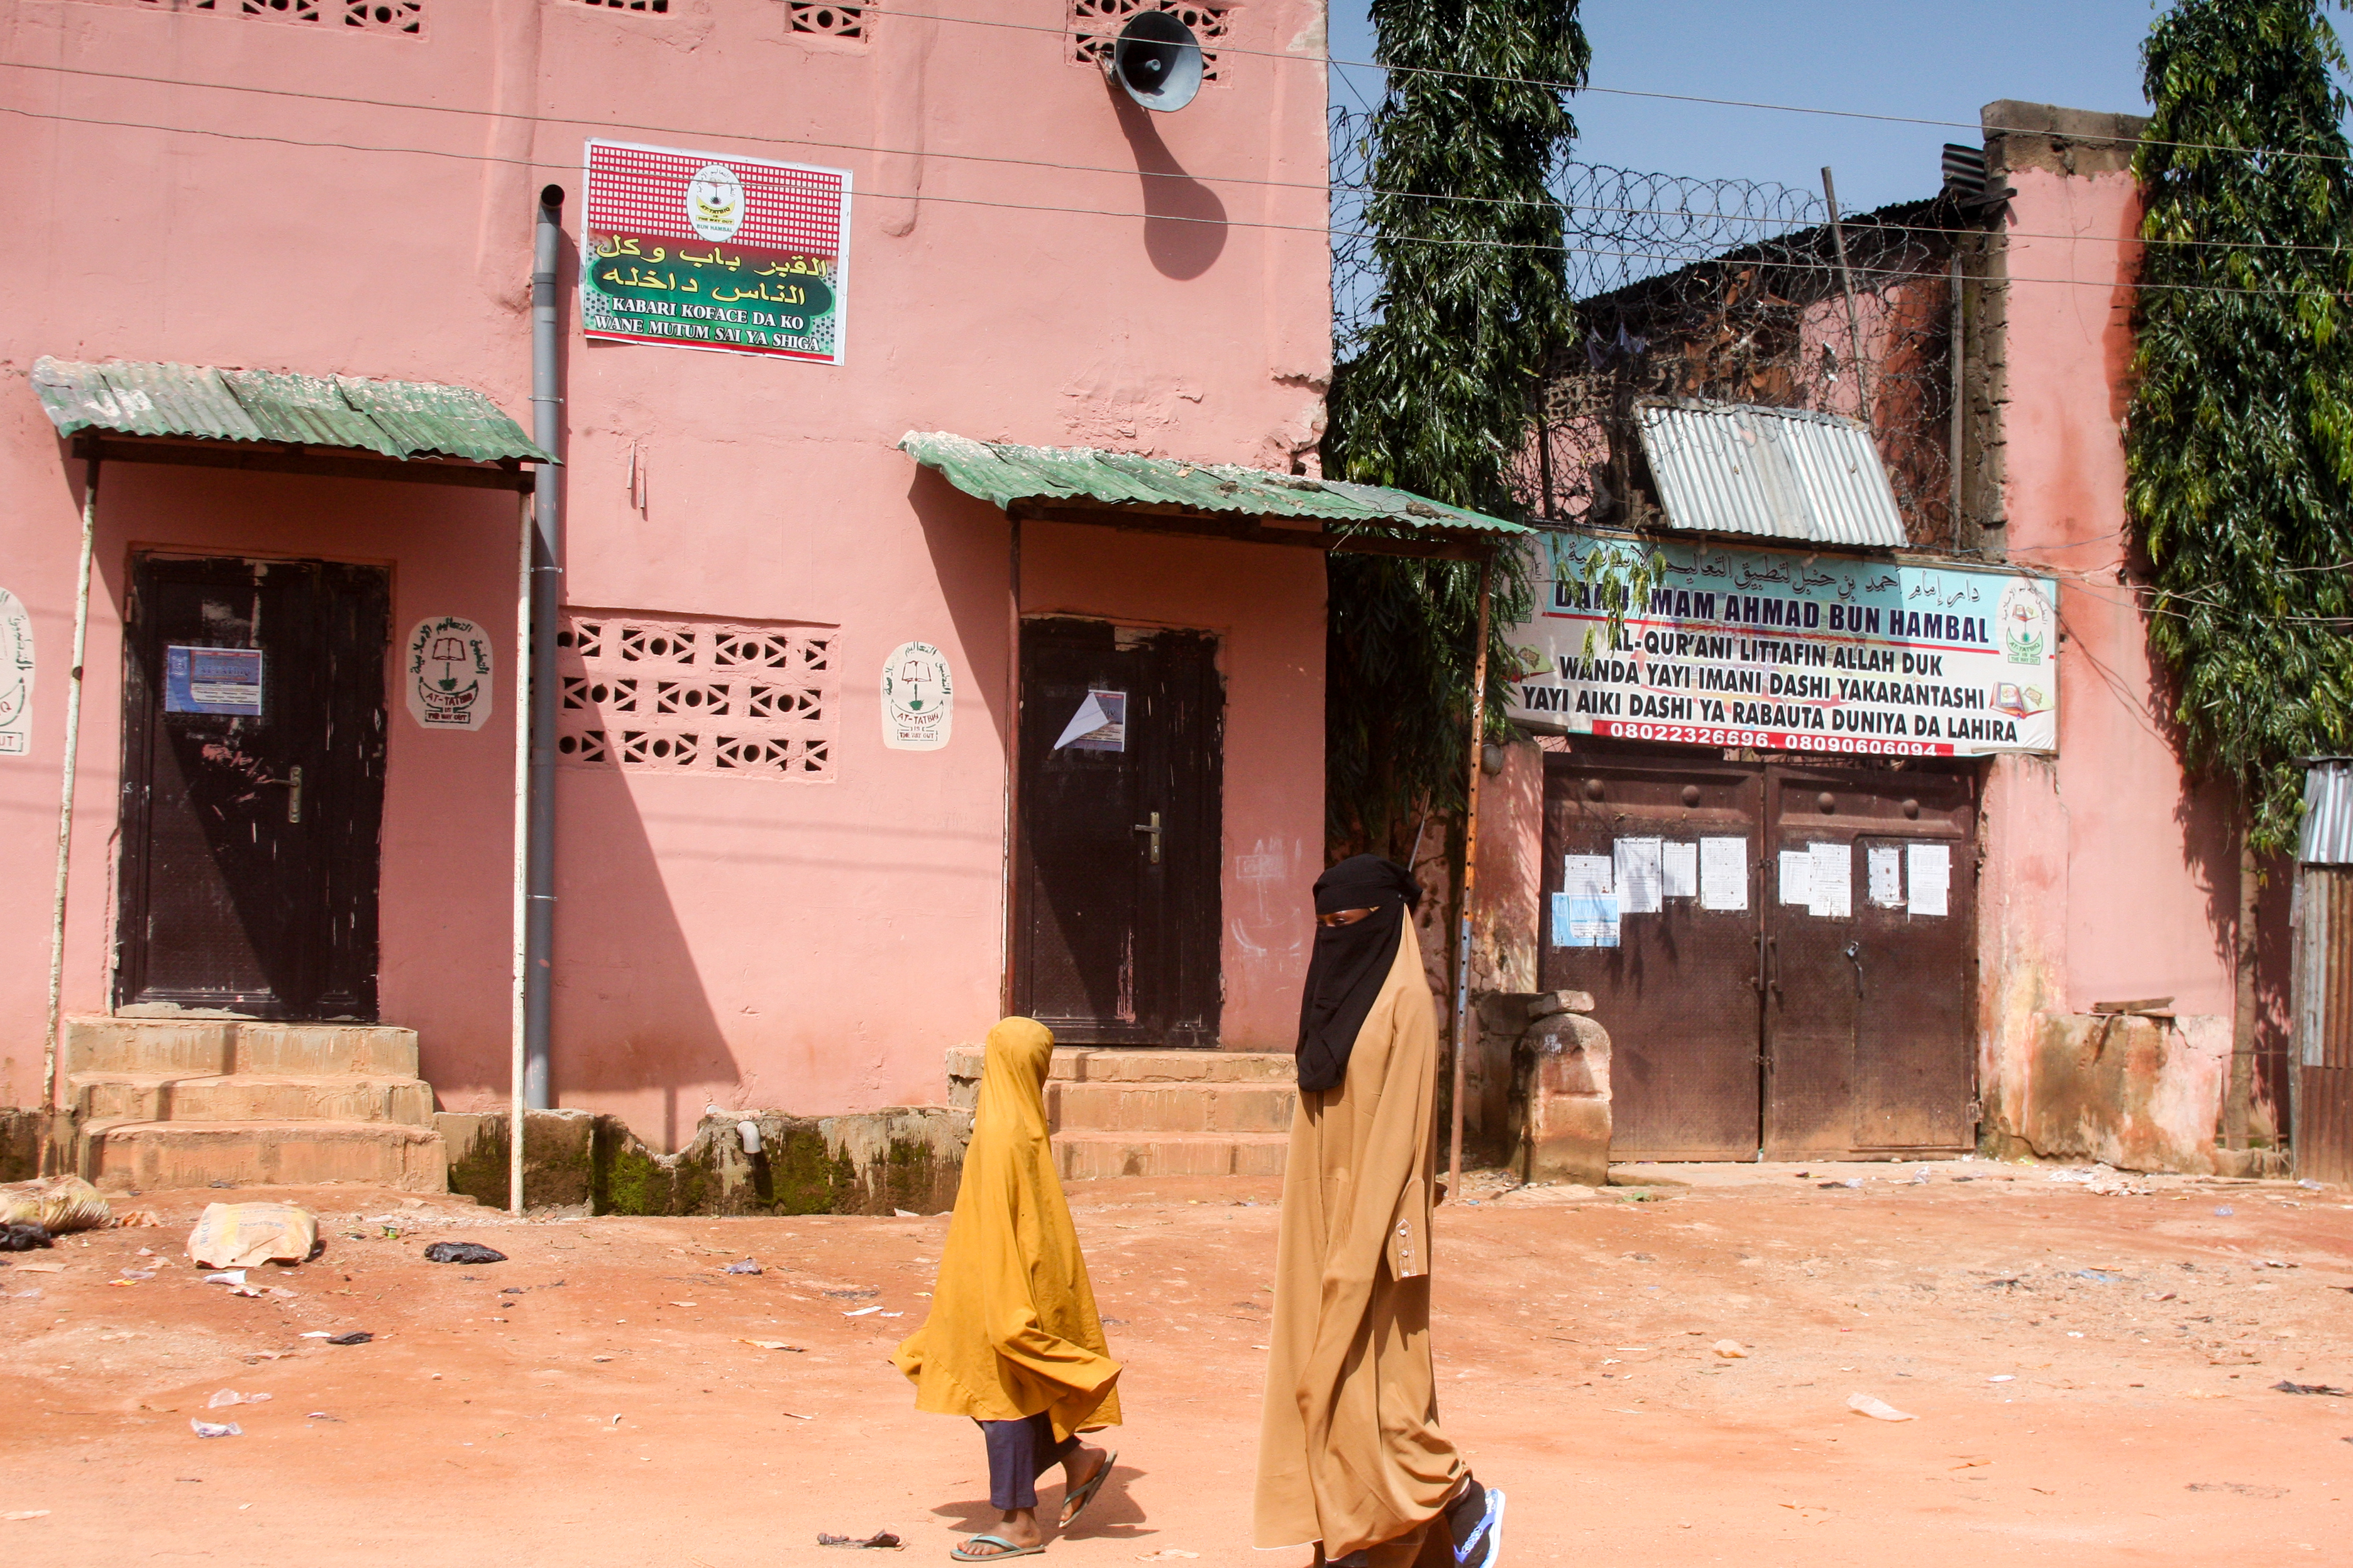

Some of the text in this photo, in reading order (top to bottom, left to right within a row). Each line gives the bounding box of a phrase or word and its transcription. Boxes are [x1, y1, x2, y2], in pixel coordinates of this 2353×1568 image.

[700, 205, 731, 214] AT-TATBIQ
[679, 246, 741, 271] باب
[753, 255, 827, 278] القبر
[602, 266, 806, 305] الناس داخله
[612, 297, 804, 330] KABARI KOFACE DA KO
[594, 314, 821, 352] WANE MUTUM SAI YA SHIGA
[1792, 562, 1836, 595] حنبل
[1837, 573, 1856, 602] بن
[1907, 569, 1944, 606] إمام
[1946, 578, 1981, 608] دار
[1724, 595, 1820, 628] AHMAD
[1829, 603, 1880, 635] BUN
[1889, 609, 1990, 644] HAMBAL
[1740, 639, 1826, 667] LITTAFIN
[1832, 647, 1895, 672] ALLAH
[1902, 652, 1943, 677] DUK
[2009, 641, 2041, 652] AT-TATBIQ
[1559, 656, 1985, 710] WANDA YAYI IMANI DASHI YAKARANTASHI
[1521, 686, 2018, 742] YAYI AIKI DASHI YA RABAUTA DUNIYA DA LAHIRA
[0, 736, 14, 747] UT
[1785, 735, 1937, 755] 08090606094
